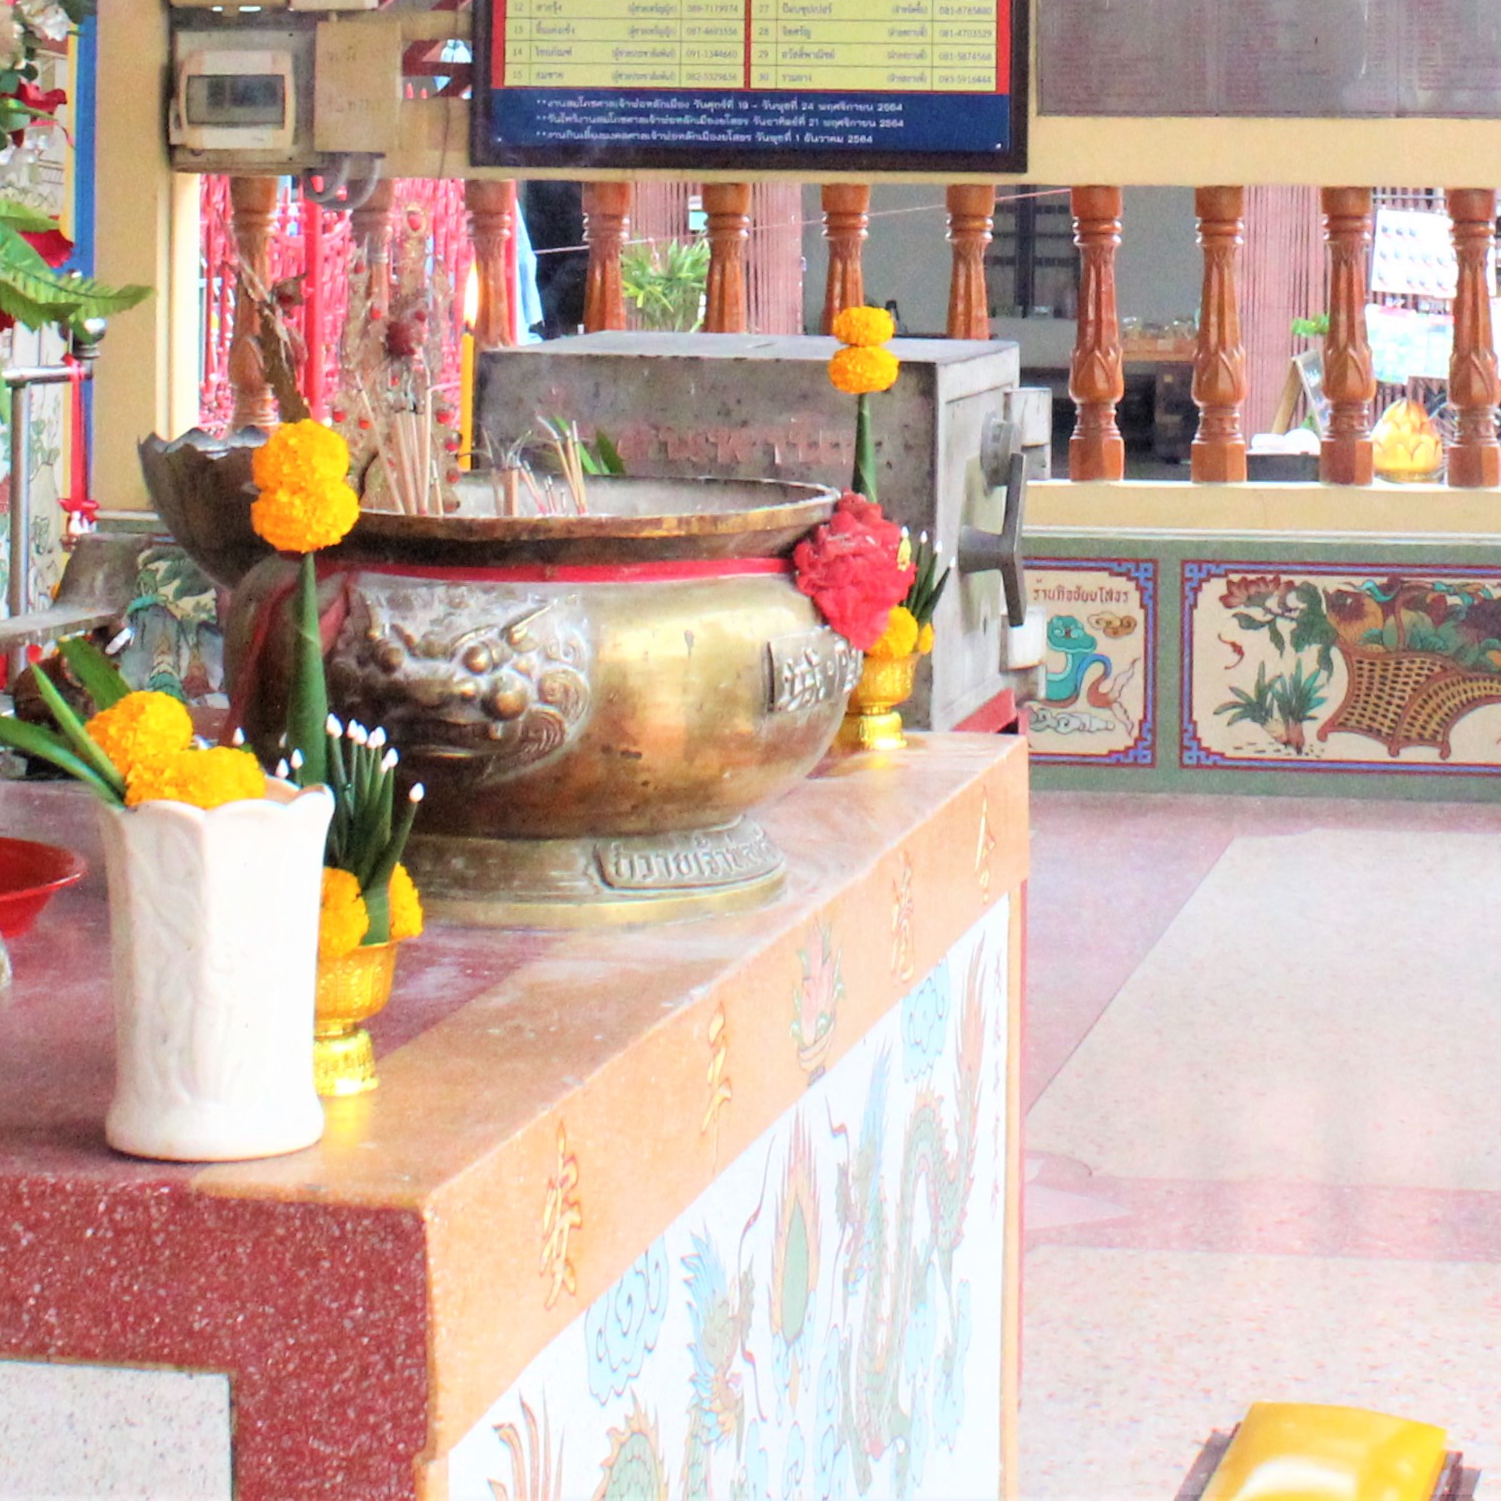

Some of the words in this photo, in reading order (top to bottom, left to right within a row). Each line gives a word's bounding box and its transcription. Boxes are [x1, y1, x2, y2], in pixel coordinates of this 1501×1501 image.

[802, 102, 814, 110] 24
[877, 103, 903, 112] 2564
[880, 119, 903, 127] 2564
[848, 135, 873, 143] 2564
